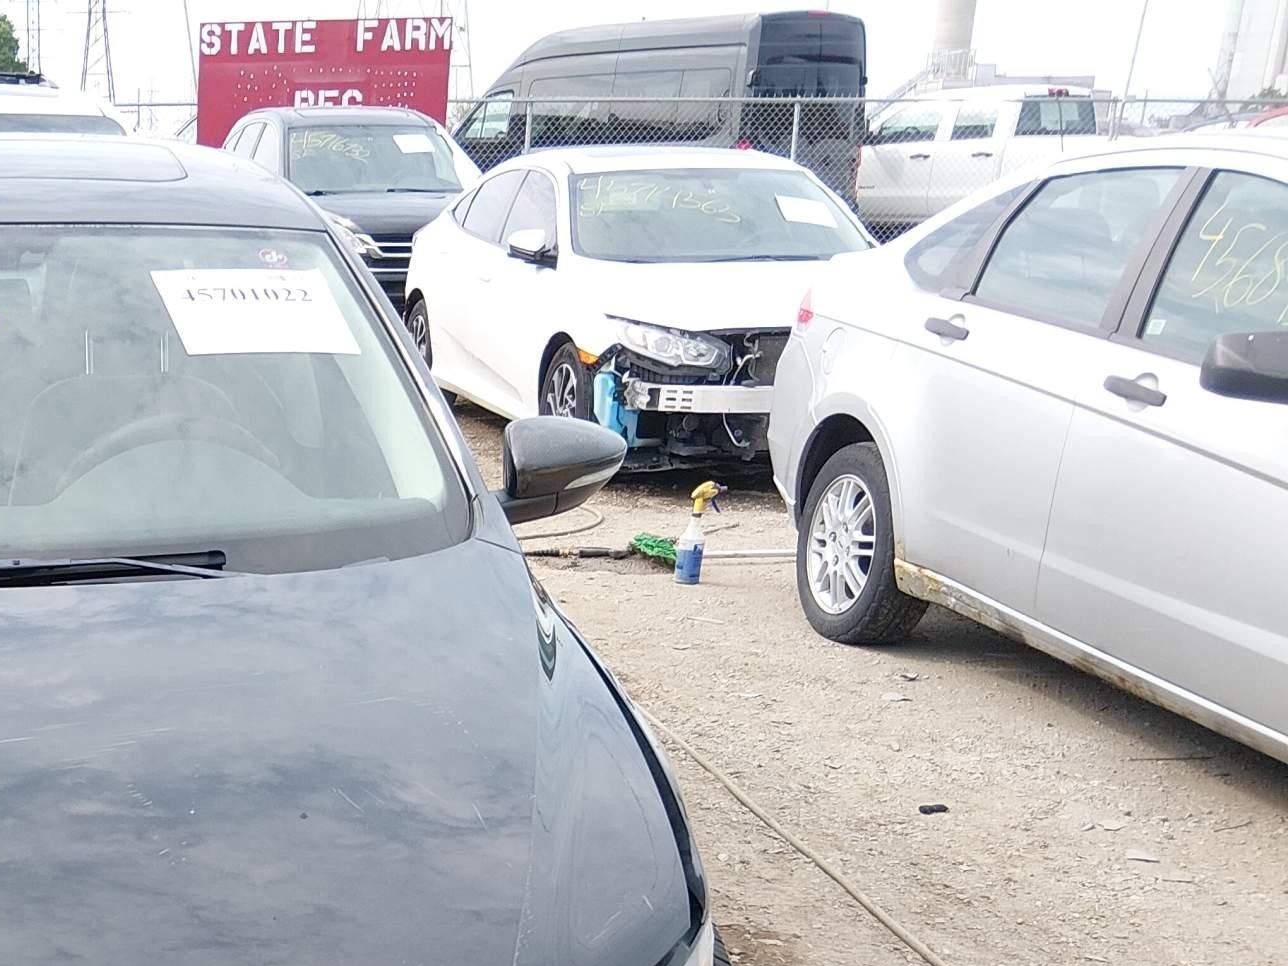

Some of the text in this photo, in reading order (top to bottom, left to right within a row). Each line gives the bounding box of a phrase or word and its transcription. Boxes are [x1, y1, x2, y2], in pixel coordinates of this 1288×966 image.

[200, 18, 453, 56] STATE FARM
[180, 287, 313, 302] 45701022
